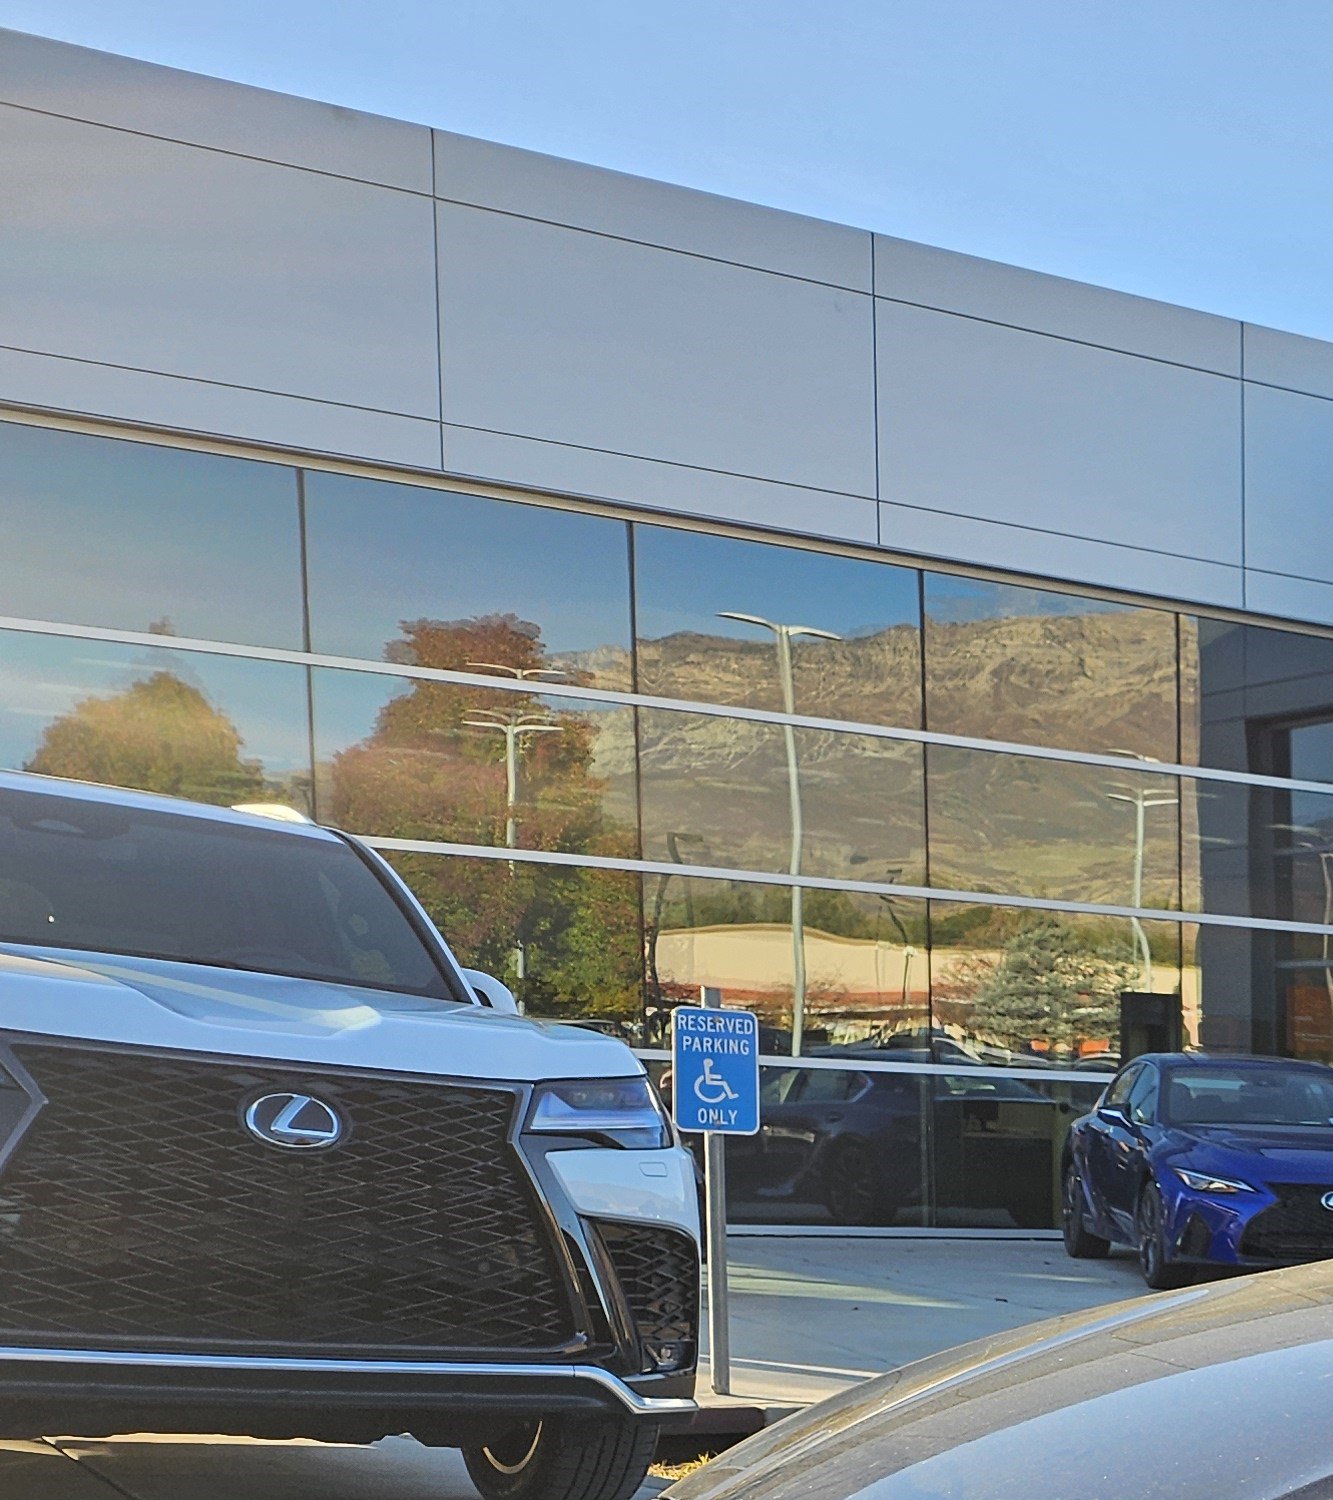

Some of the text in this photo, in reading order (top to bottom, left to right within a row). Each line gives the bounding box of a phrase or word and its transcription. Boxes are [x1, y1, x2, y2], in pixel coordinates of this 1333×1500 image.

[678, 1014, 754, 1035] RESERVED
[683, 1036, 750, 1056] PARKING
[698, 1107, 738, 1126] ONLY
